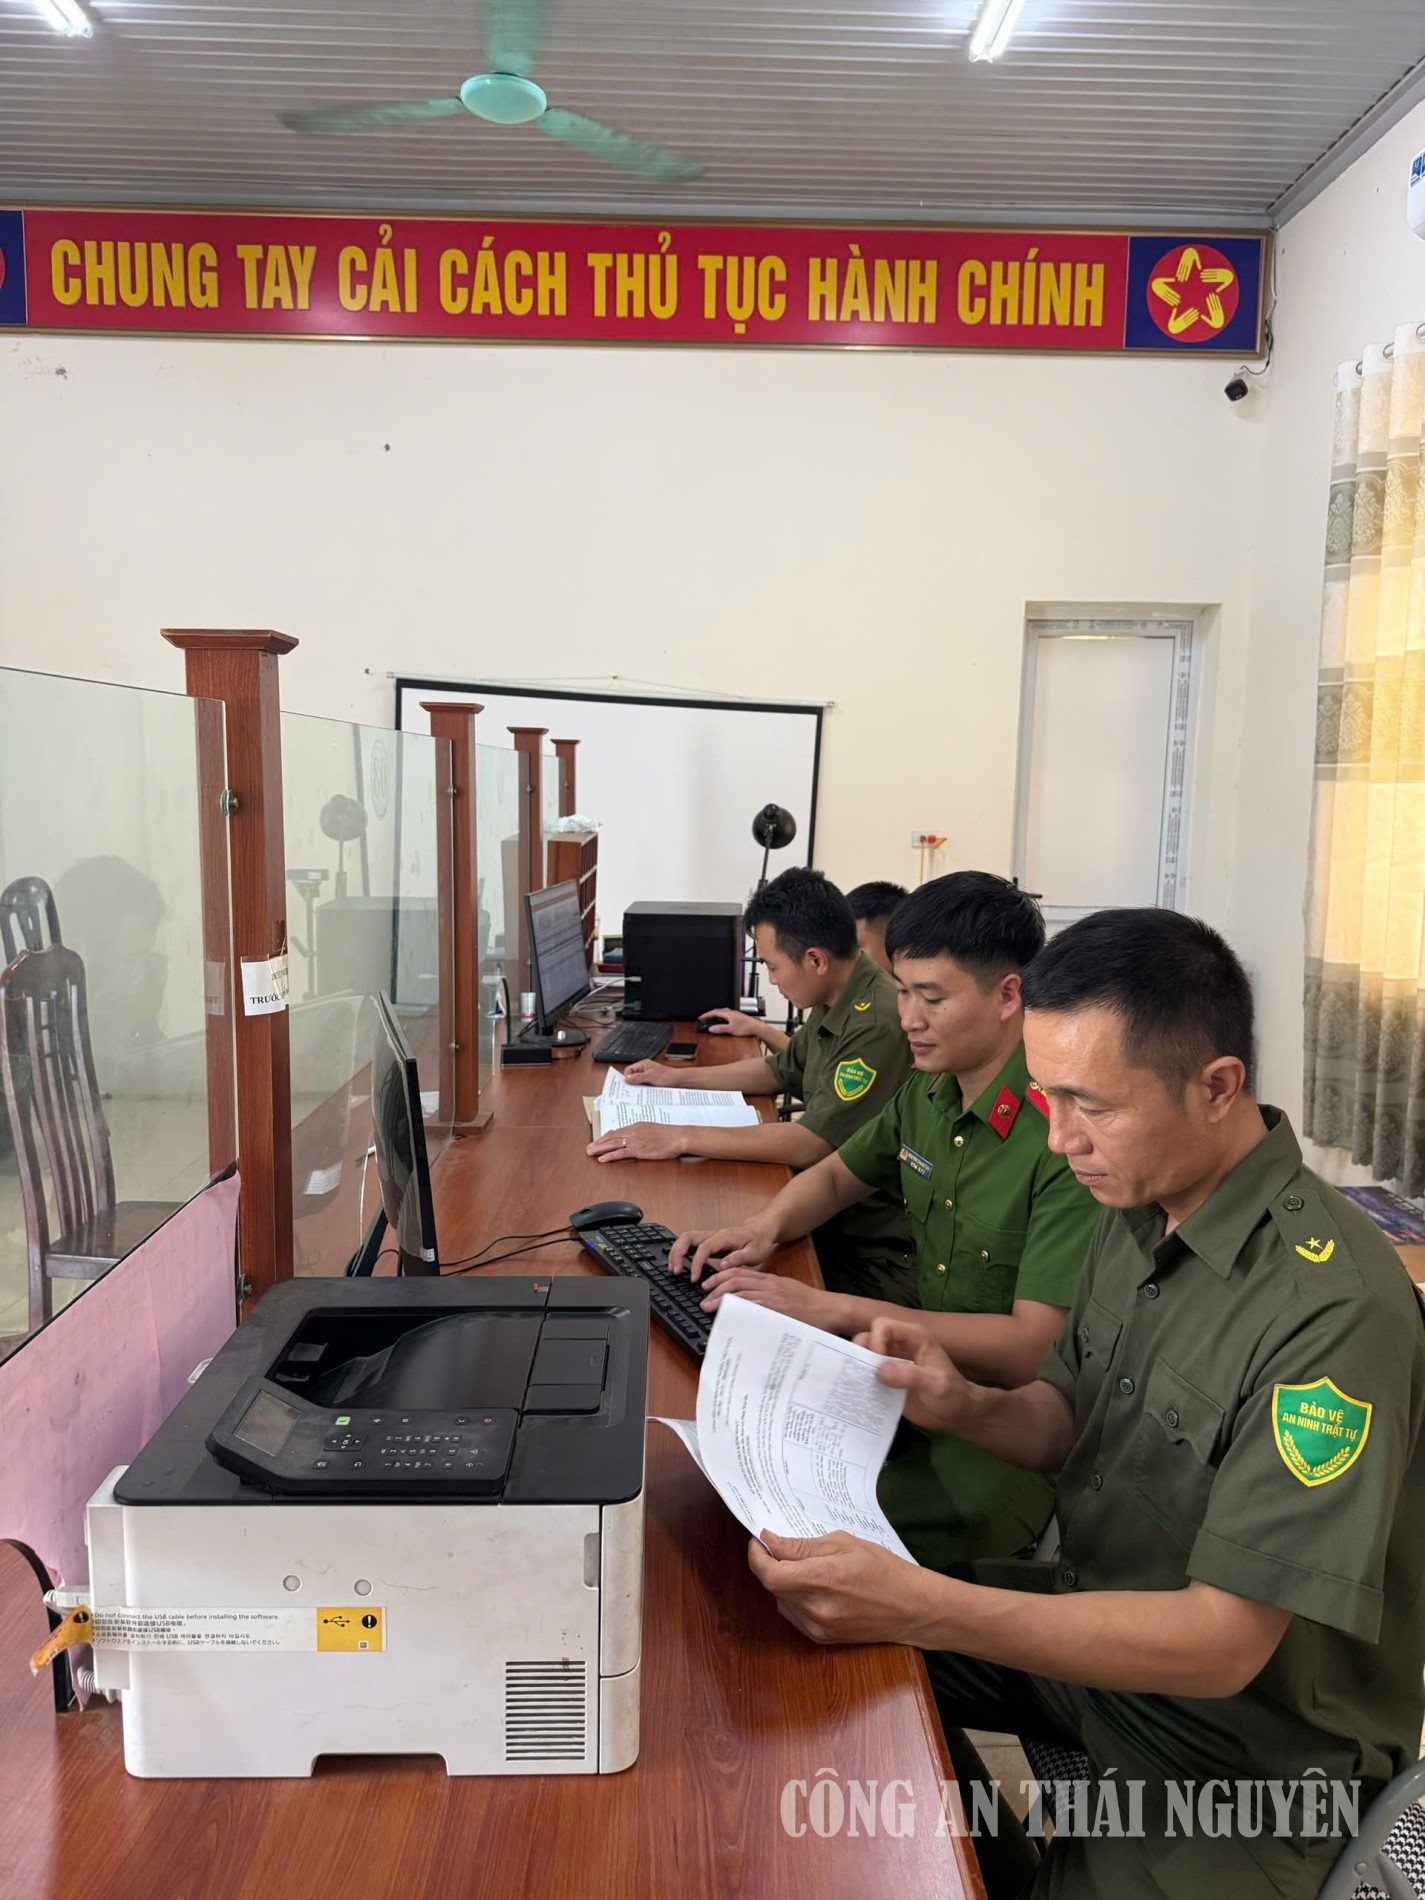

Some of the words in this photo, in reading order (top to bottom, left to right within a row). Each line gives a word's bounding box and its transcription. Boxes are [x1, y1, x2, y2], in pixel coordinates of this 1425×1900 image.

[51, 239, 220, 309] CHUNG
[236, 244, 317, 310] TAY
[338, 224, 418, 313] CẢI
[439, 236, 566, 316] CÁCH
[587, 231, 678, 320] THỦ
[698, 255, 786, 334] TỤC
[808, 244, 938, 324] HÀNH
[957, 248, 1105, 327] CHÍNH
[1300, 1402, 1325, 1419] BẢO
[1328, 1409, 1344, 1424] VỆ
[1282, 1412, 1296, 1424] AN
[1297, 1416, 1320, 1432] NINH
[1321, 1422, 1344, 1438] TRẬT
[1345, 1428, 1358, 1442] TỰ
[208, 1613, 237, 1621] installing
